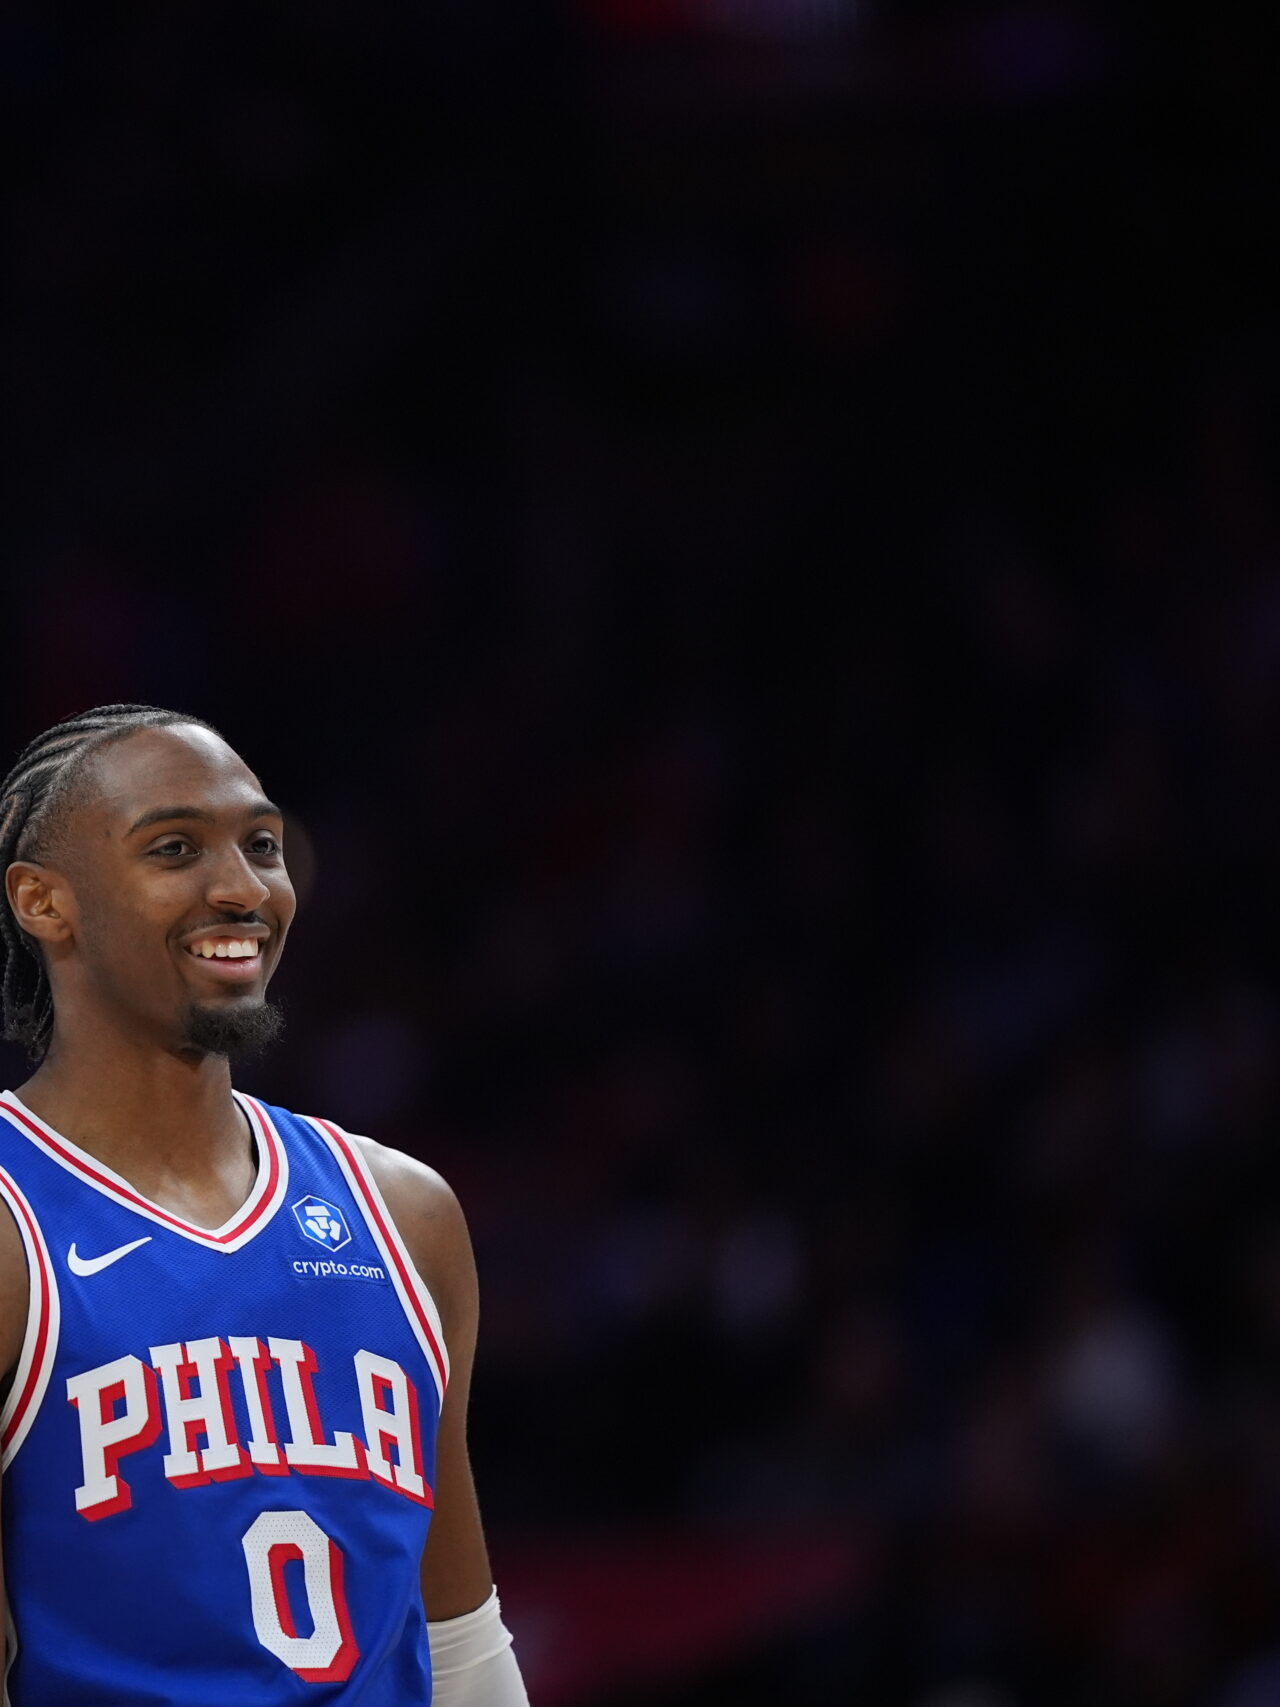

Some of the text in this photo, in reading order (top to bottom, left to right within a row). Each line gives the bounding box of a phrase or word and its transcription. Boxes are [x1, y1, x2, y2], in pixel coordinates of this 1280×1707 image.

[293, 1260, 385, 1279] crypto.com
[66, 1335, 434, 1522] PHILA
[241, 1510, 361, 1683] 0
